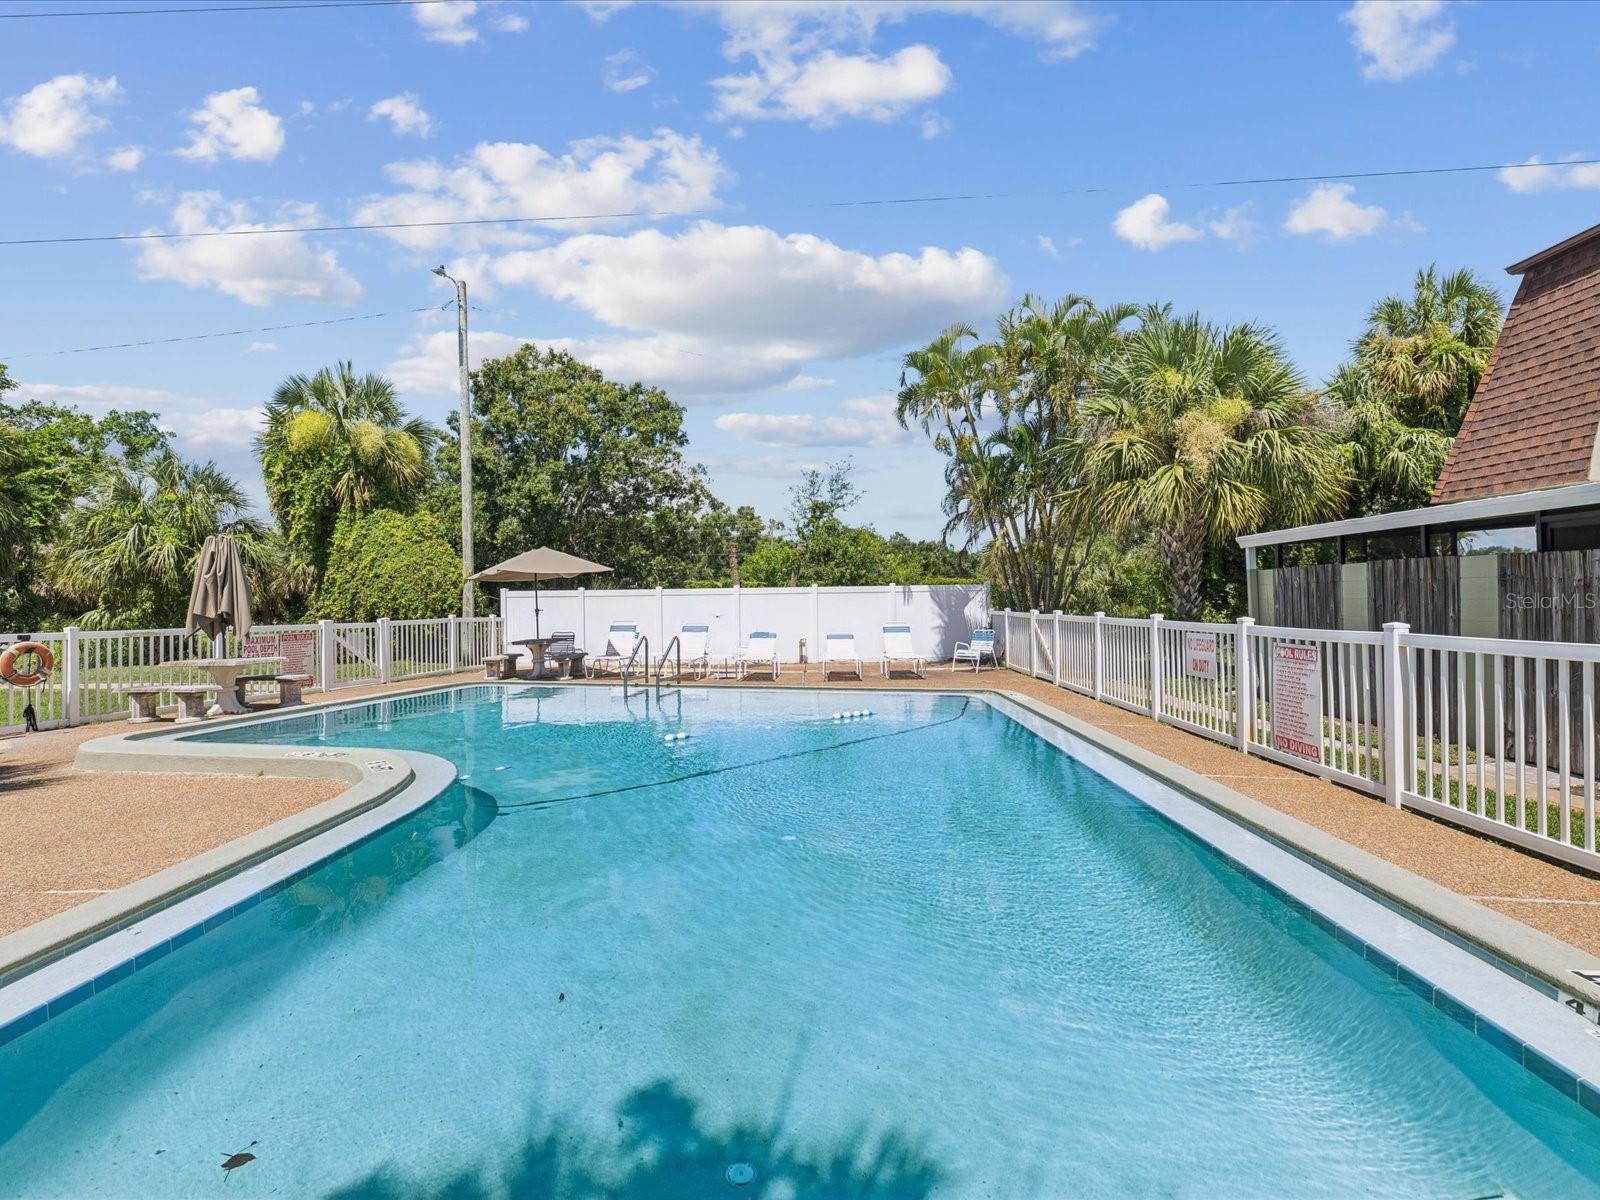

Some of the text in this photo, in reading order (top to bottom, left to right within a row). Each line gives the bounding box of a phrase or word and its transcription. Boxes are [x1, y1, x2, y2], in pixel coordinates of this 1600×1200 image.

[245, 635, 276, 645] MAXIMUM
[244, 644, 278, 654] POOL DEPTH
[1276, 646, 1317, 661] POOL RULES
[1277, 736, 1318, 757] NO DIVING
[1565, 999, 1586, 1016] 4
